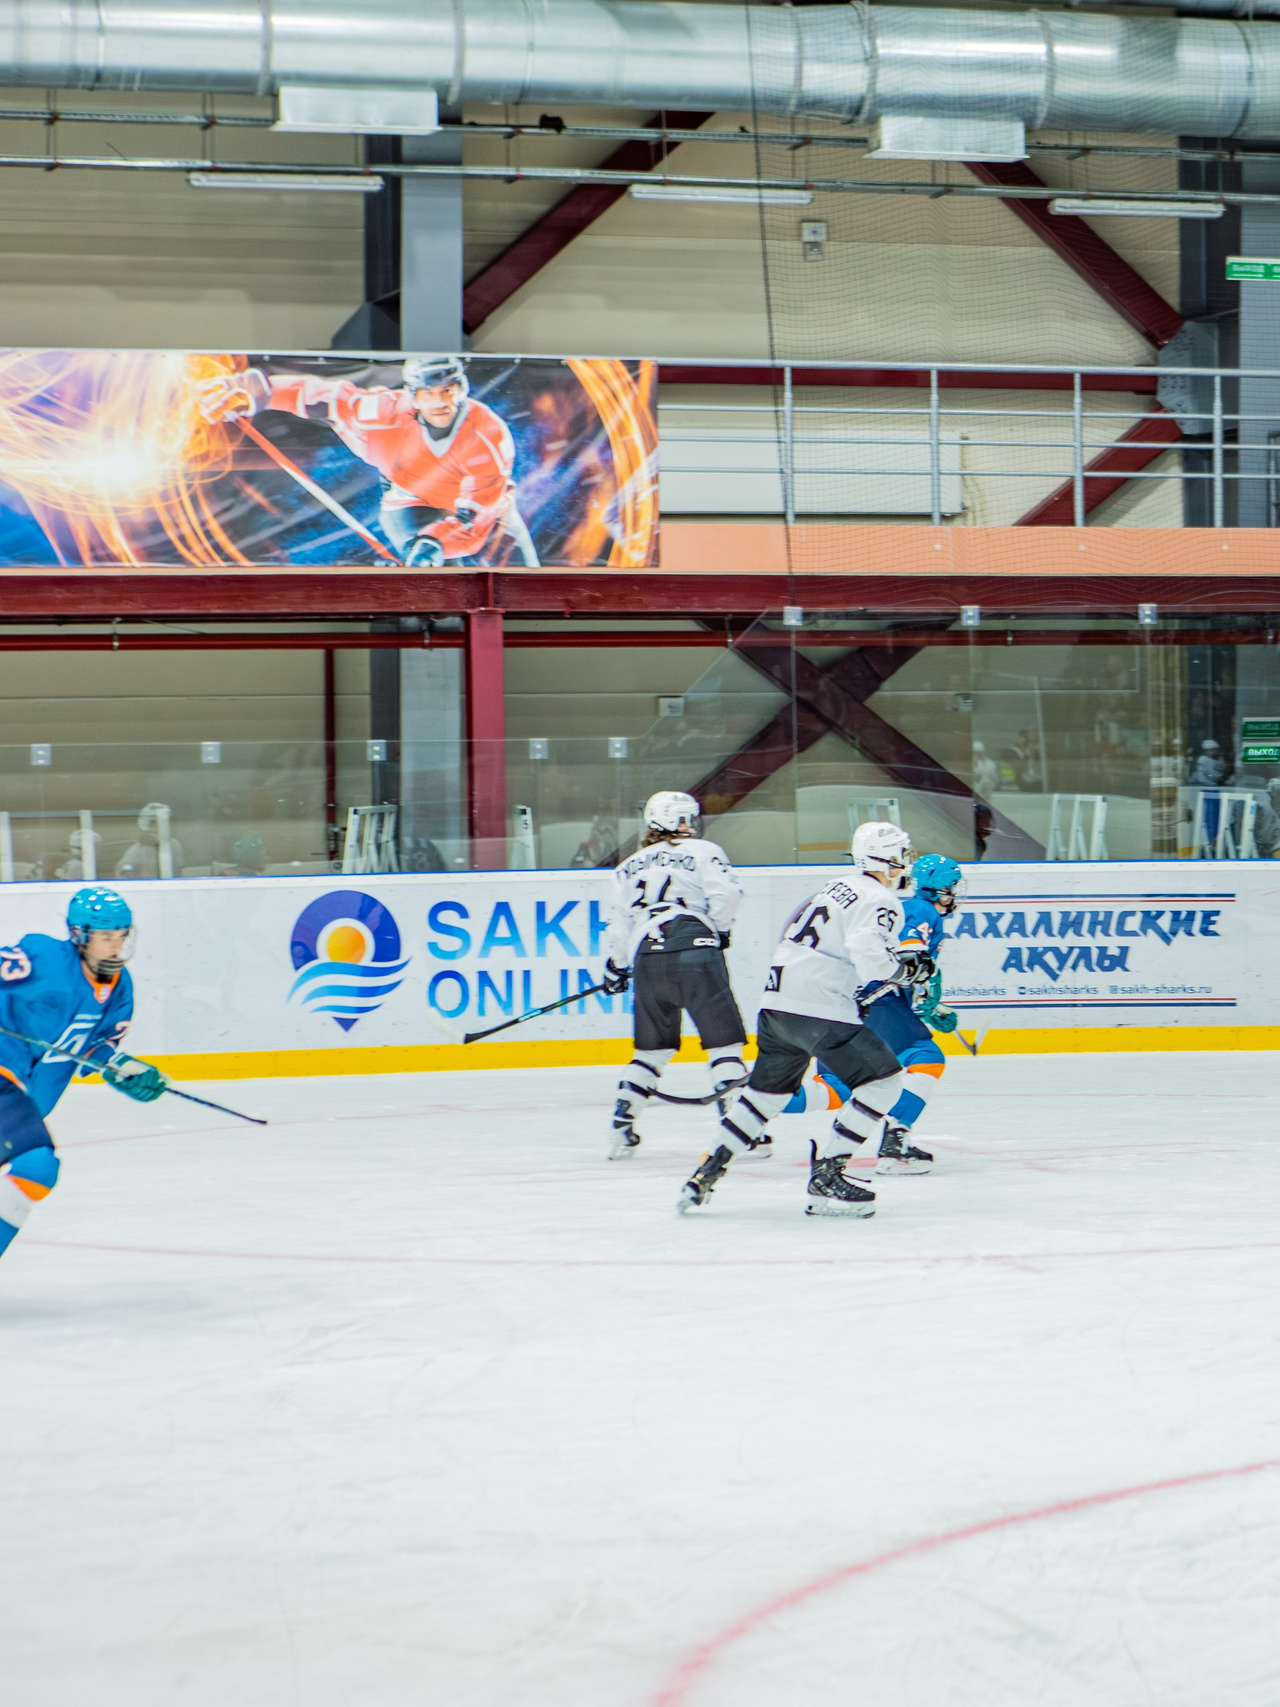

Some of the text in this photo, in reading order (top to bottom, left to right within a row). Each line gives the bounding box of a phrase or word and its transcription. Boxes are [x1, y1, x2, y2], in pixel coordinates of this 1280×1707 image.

[1247, 748, 1280, 757] ВЫХОД
[1001, 945, 1131, 982] АКУЛЫ
[427, 968, 635, 1019] ONLIN
[943, 985, 1007, 996] akhsharks
[1029, 984, 1099, 995] sakhsharks
[1120, 983, 1212, 994] sakh-sharks.ru
